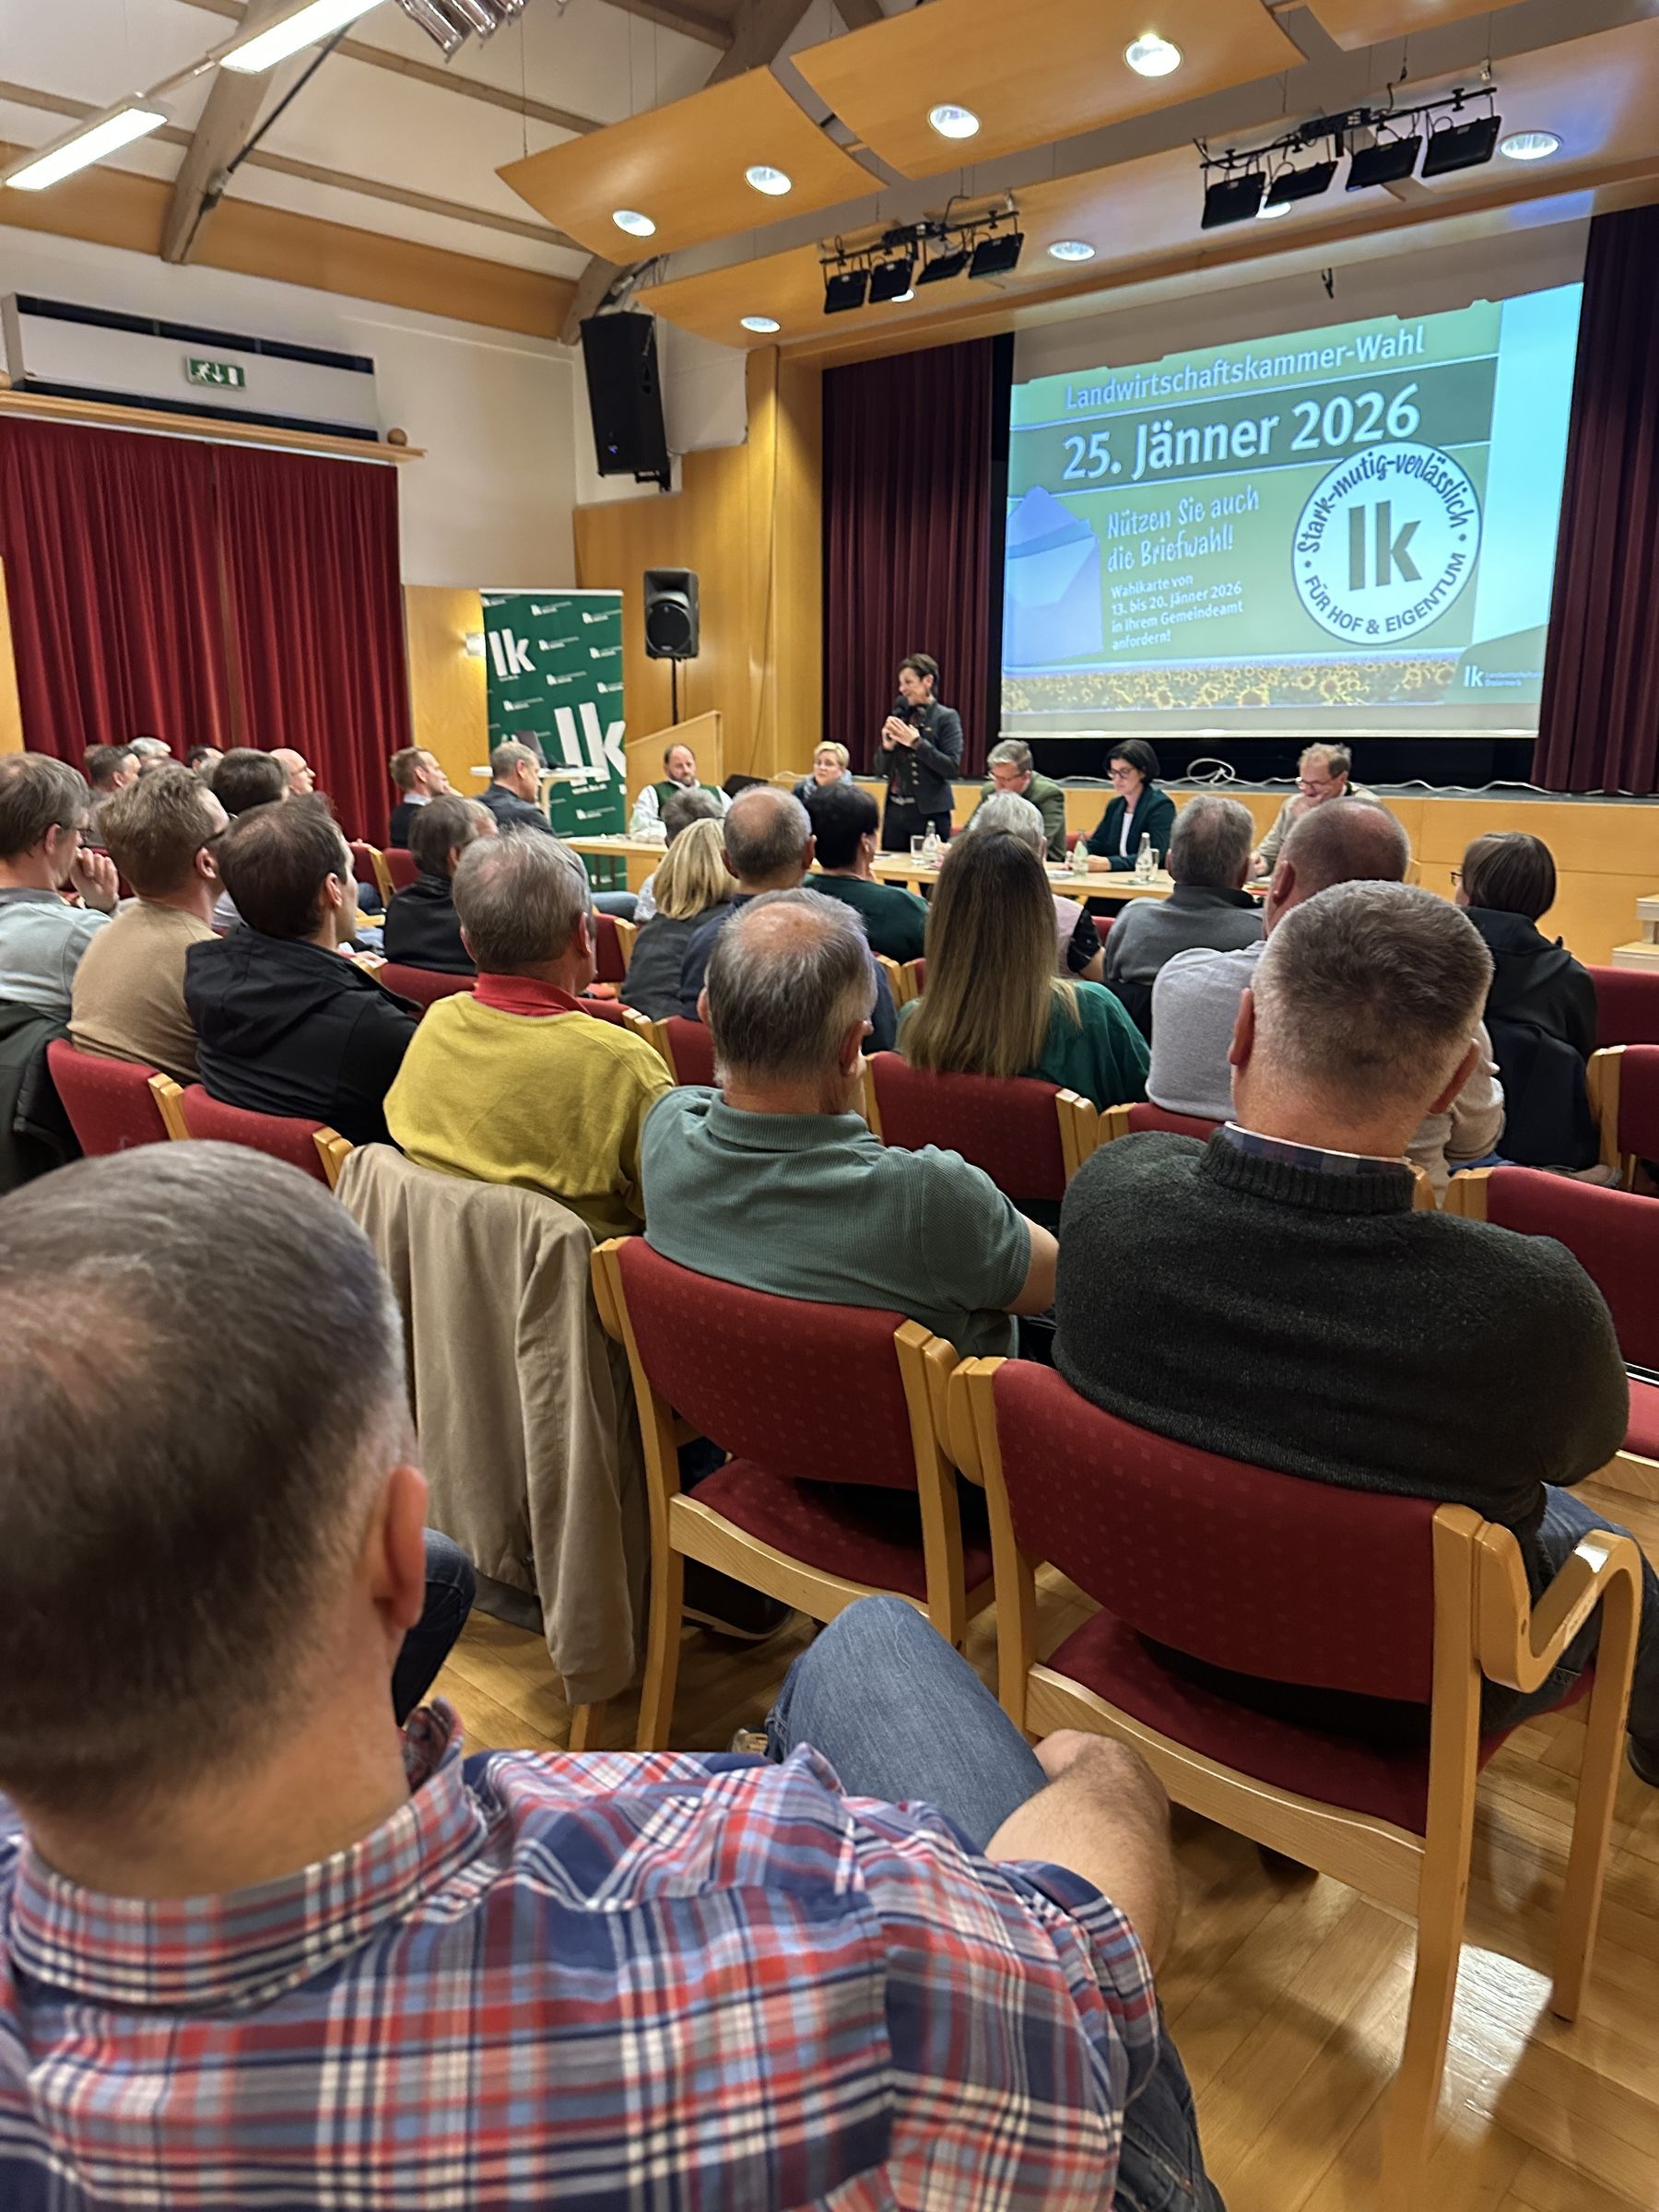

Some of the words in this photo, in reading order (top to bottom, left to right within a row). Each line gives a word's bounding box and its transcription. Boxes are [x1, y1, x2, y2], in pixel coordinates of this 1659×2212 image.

[1065, 326, 1425, 410] Landwirtschaftskammer-Wahl
[1062, 432, 1123, 480] 25.
[1131, 412, 1278, 480] Jänner
[1291, 382, 1420, 450] 2026
[1108, 509, 1171, 539] Nützen
[1178, 496, 1206, 525] Sie
[1211, 485, 1259, 519] auch
[1108, 545, 1135, 572] die
[1141, 524, 1233, 567] Briefwahl!
[1348, 500, 1423, 592] lk
[1111, 580, 1170, 598] Wahlkarte
[1172, 574, 1194, 588] von
[1111, 604, 1128, 616] 13.
[1130, 600, 1147, 613] bis
[1149, 596, 1168, 610] 20.
[1170, 589, 1208, 608] Jänner
[1211, 582, 1242, 598] 2026
[1304, 575, 1332, 612] FÜR
[1327, 605, 1364, 632] HOF
[1365, 618, 1381, 635] &
[1385, 551, 1466, 632] EIGENTUM
[1112, 620, 1123, 634] in
[1124, 616, 1159, 631] Ihrem
[1160, 600, 1244, 626] Gemeindeamt
[1112, 629, 1171, 652] anfordern!
[488, 628, 537, 677] lk
